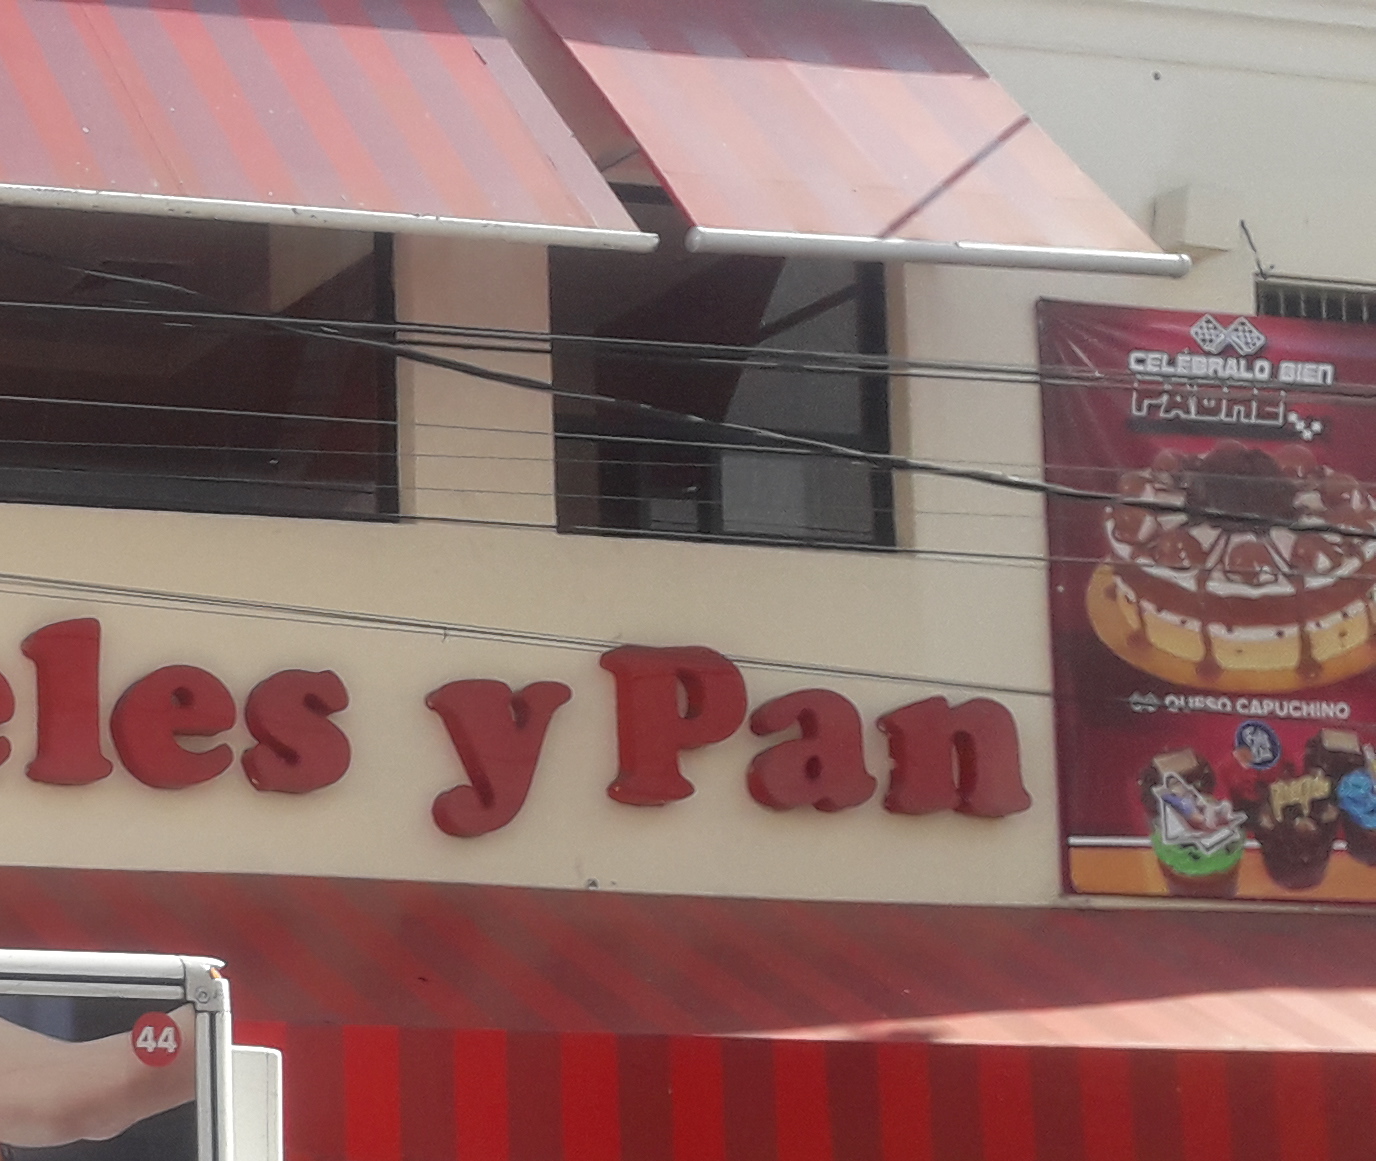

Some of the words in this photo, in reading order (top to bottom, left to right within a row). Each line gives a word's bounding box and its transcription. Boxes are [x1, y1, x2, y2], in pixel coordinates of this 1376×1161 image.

[1236, 698, 1352, 720] CAPUCHINO
[426, 679, 573, 838] y
[600, 645, 1033, 818] Pan
[136, 1025, 179, 1053] 44
